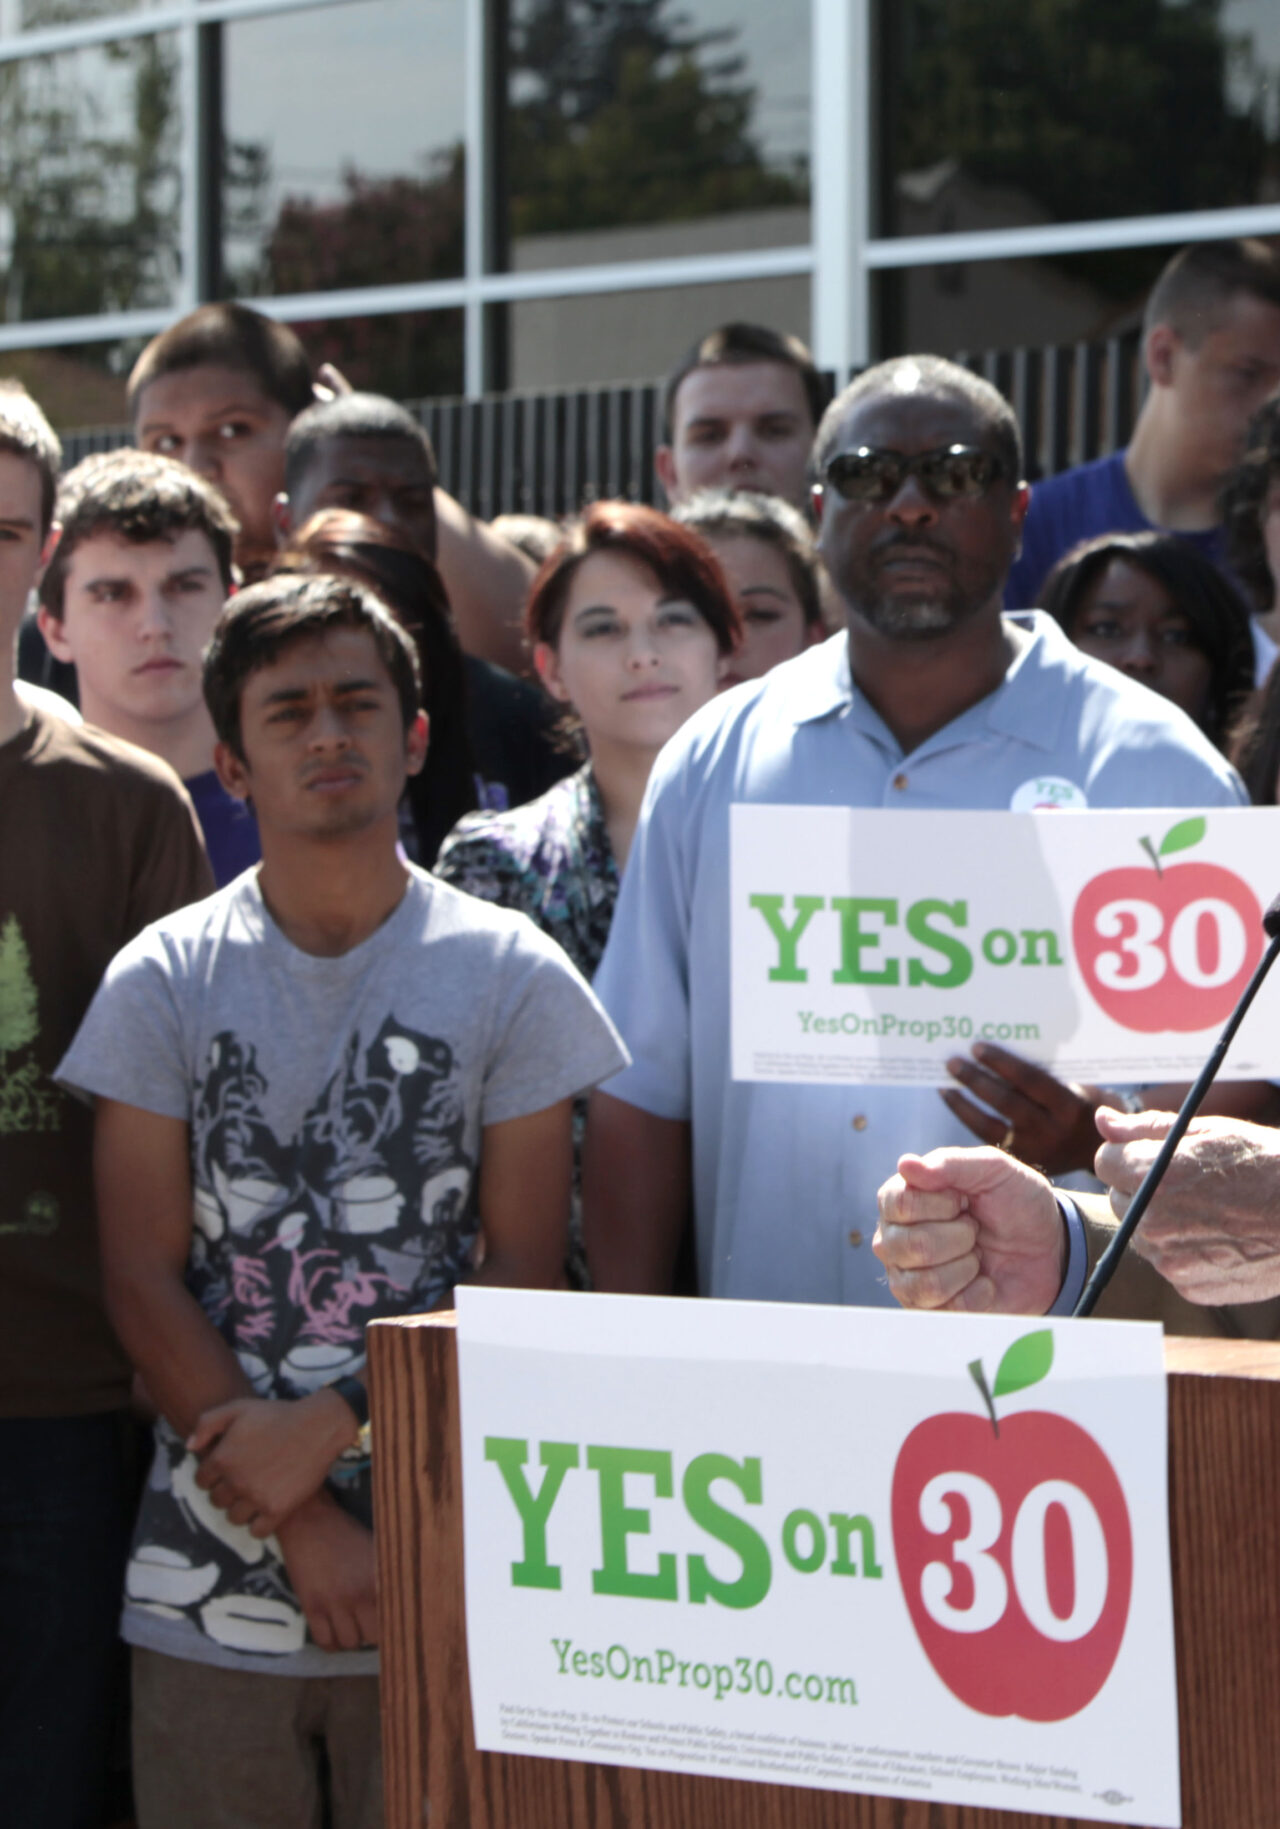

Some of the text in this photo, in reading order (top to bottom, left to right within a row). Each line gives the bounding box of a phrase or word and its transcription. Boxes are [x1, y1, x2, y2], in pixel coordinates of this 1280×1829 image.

[748, 893, 1247, 991] YES on 30
[797, 1011, 1041, 1042] YesOnProp30.com
[484, 1435, 1109, 1642] YES on 30
[551, 1638, 859, 1706] YesOnProp30.com
